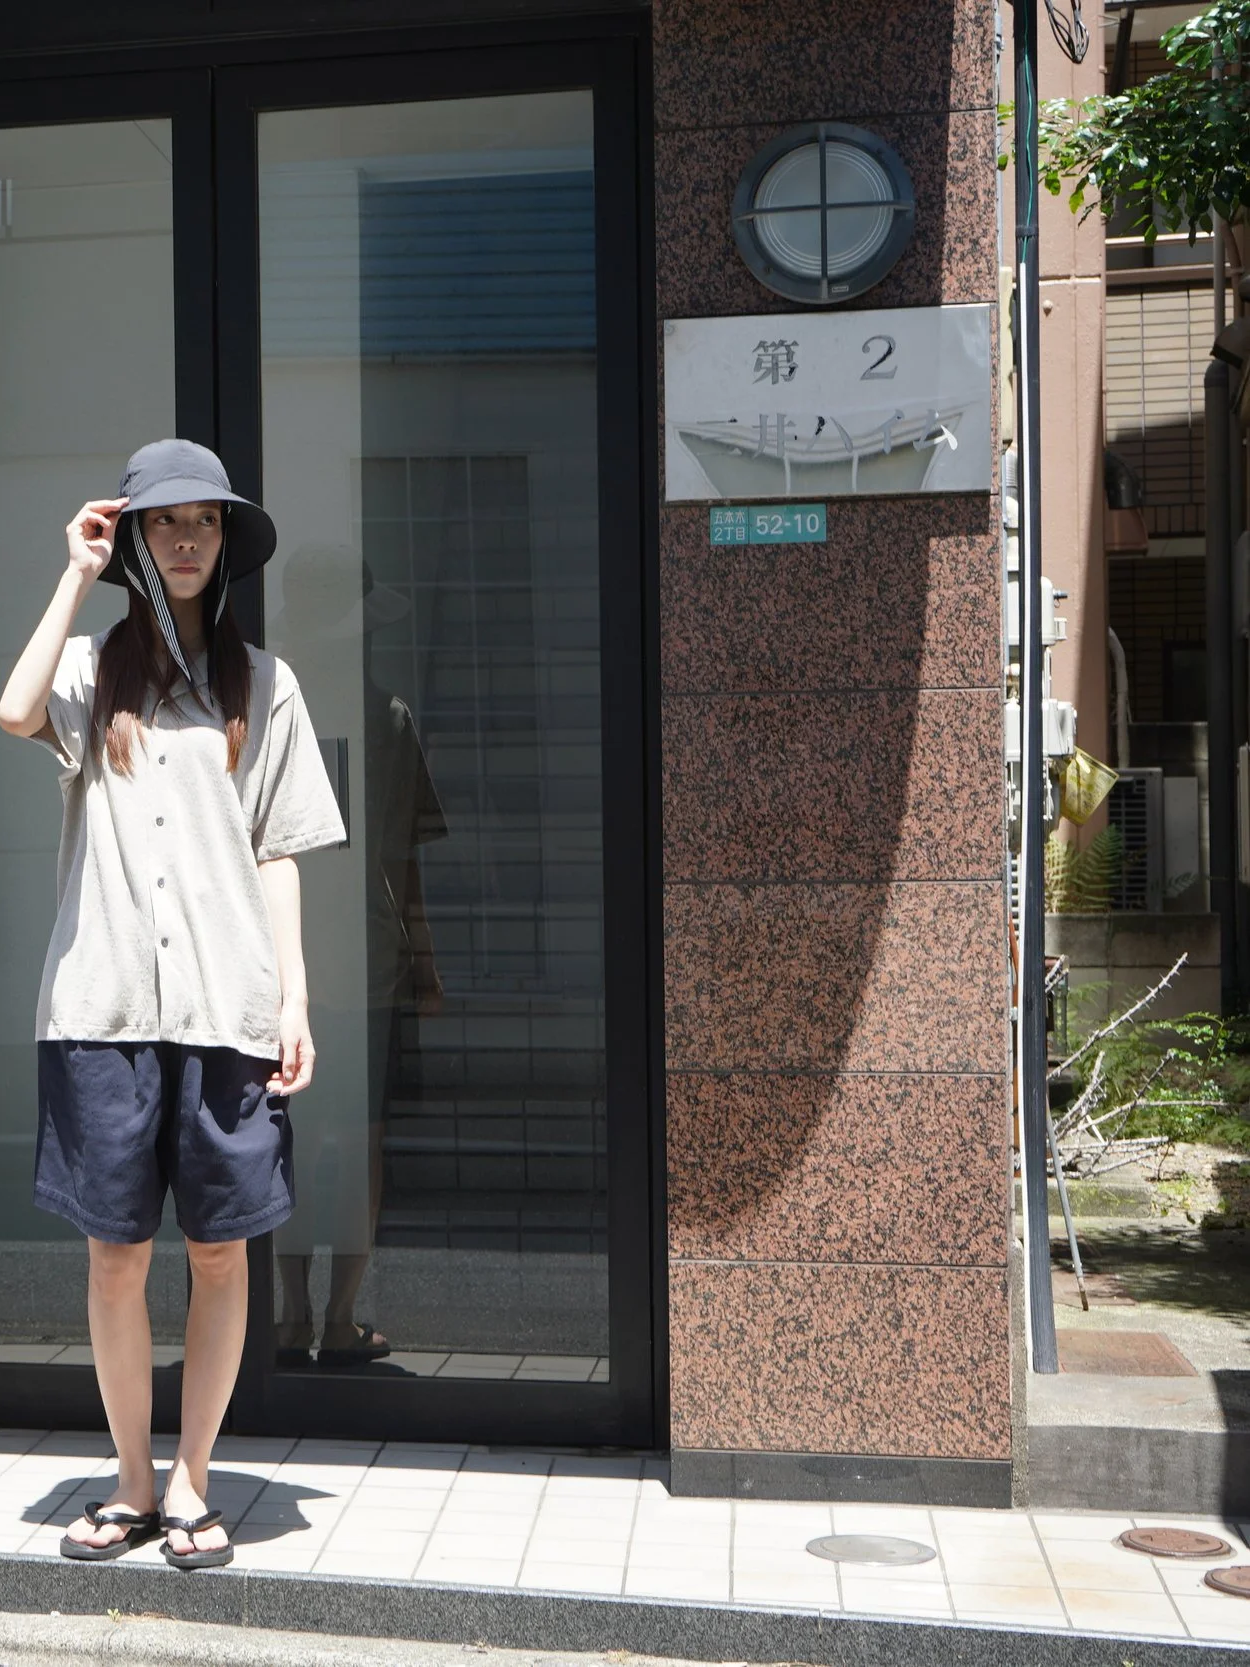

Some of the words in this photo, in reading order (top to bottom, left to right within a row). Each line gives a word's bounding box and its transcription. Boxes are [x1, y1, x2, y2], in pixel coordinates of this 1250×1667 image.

[752, 339, 799, 385] 第
[859, 335, 898, 380] 2
[714, 511, 745, 524] 五本木
[756, 513, 820, 535] 52-10
[714, 527, 745, 541] 2丁目
